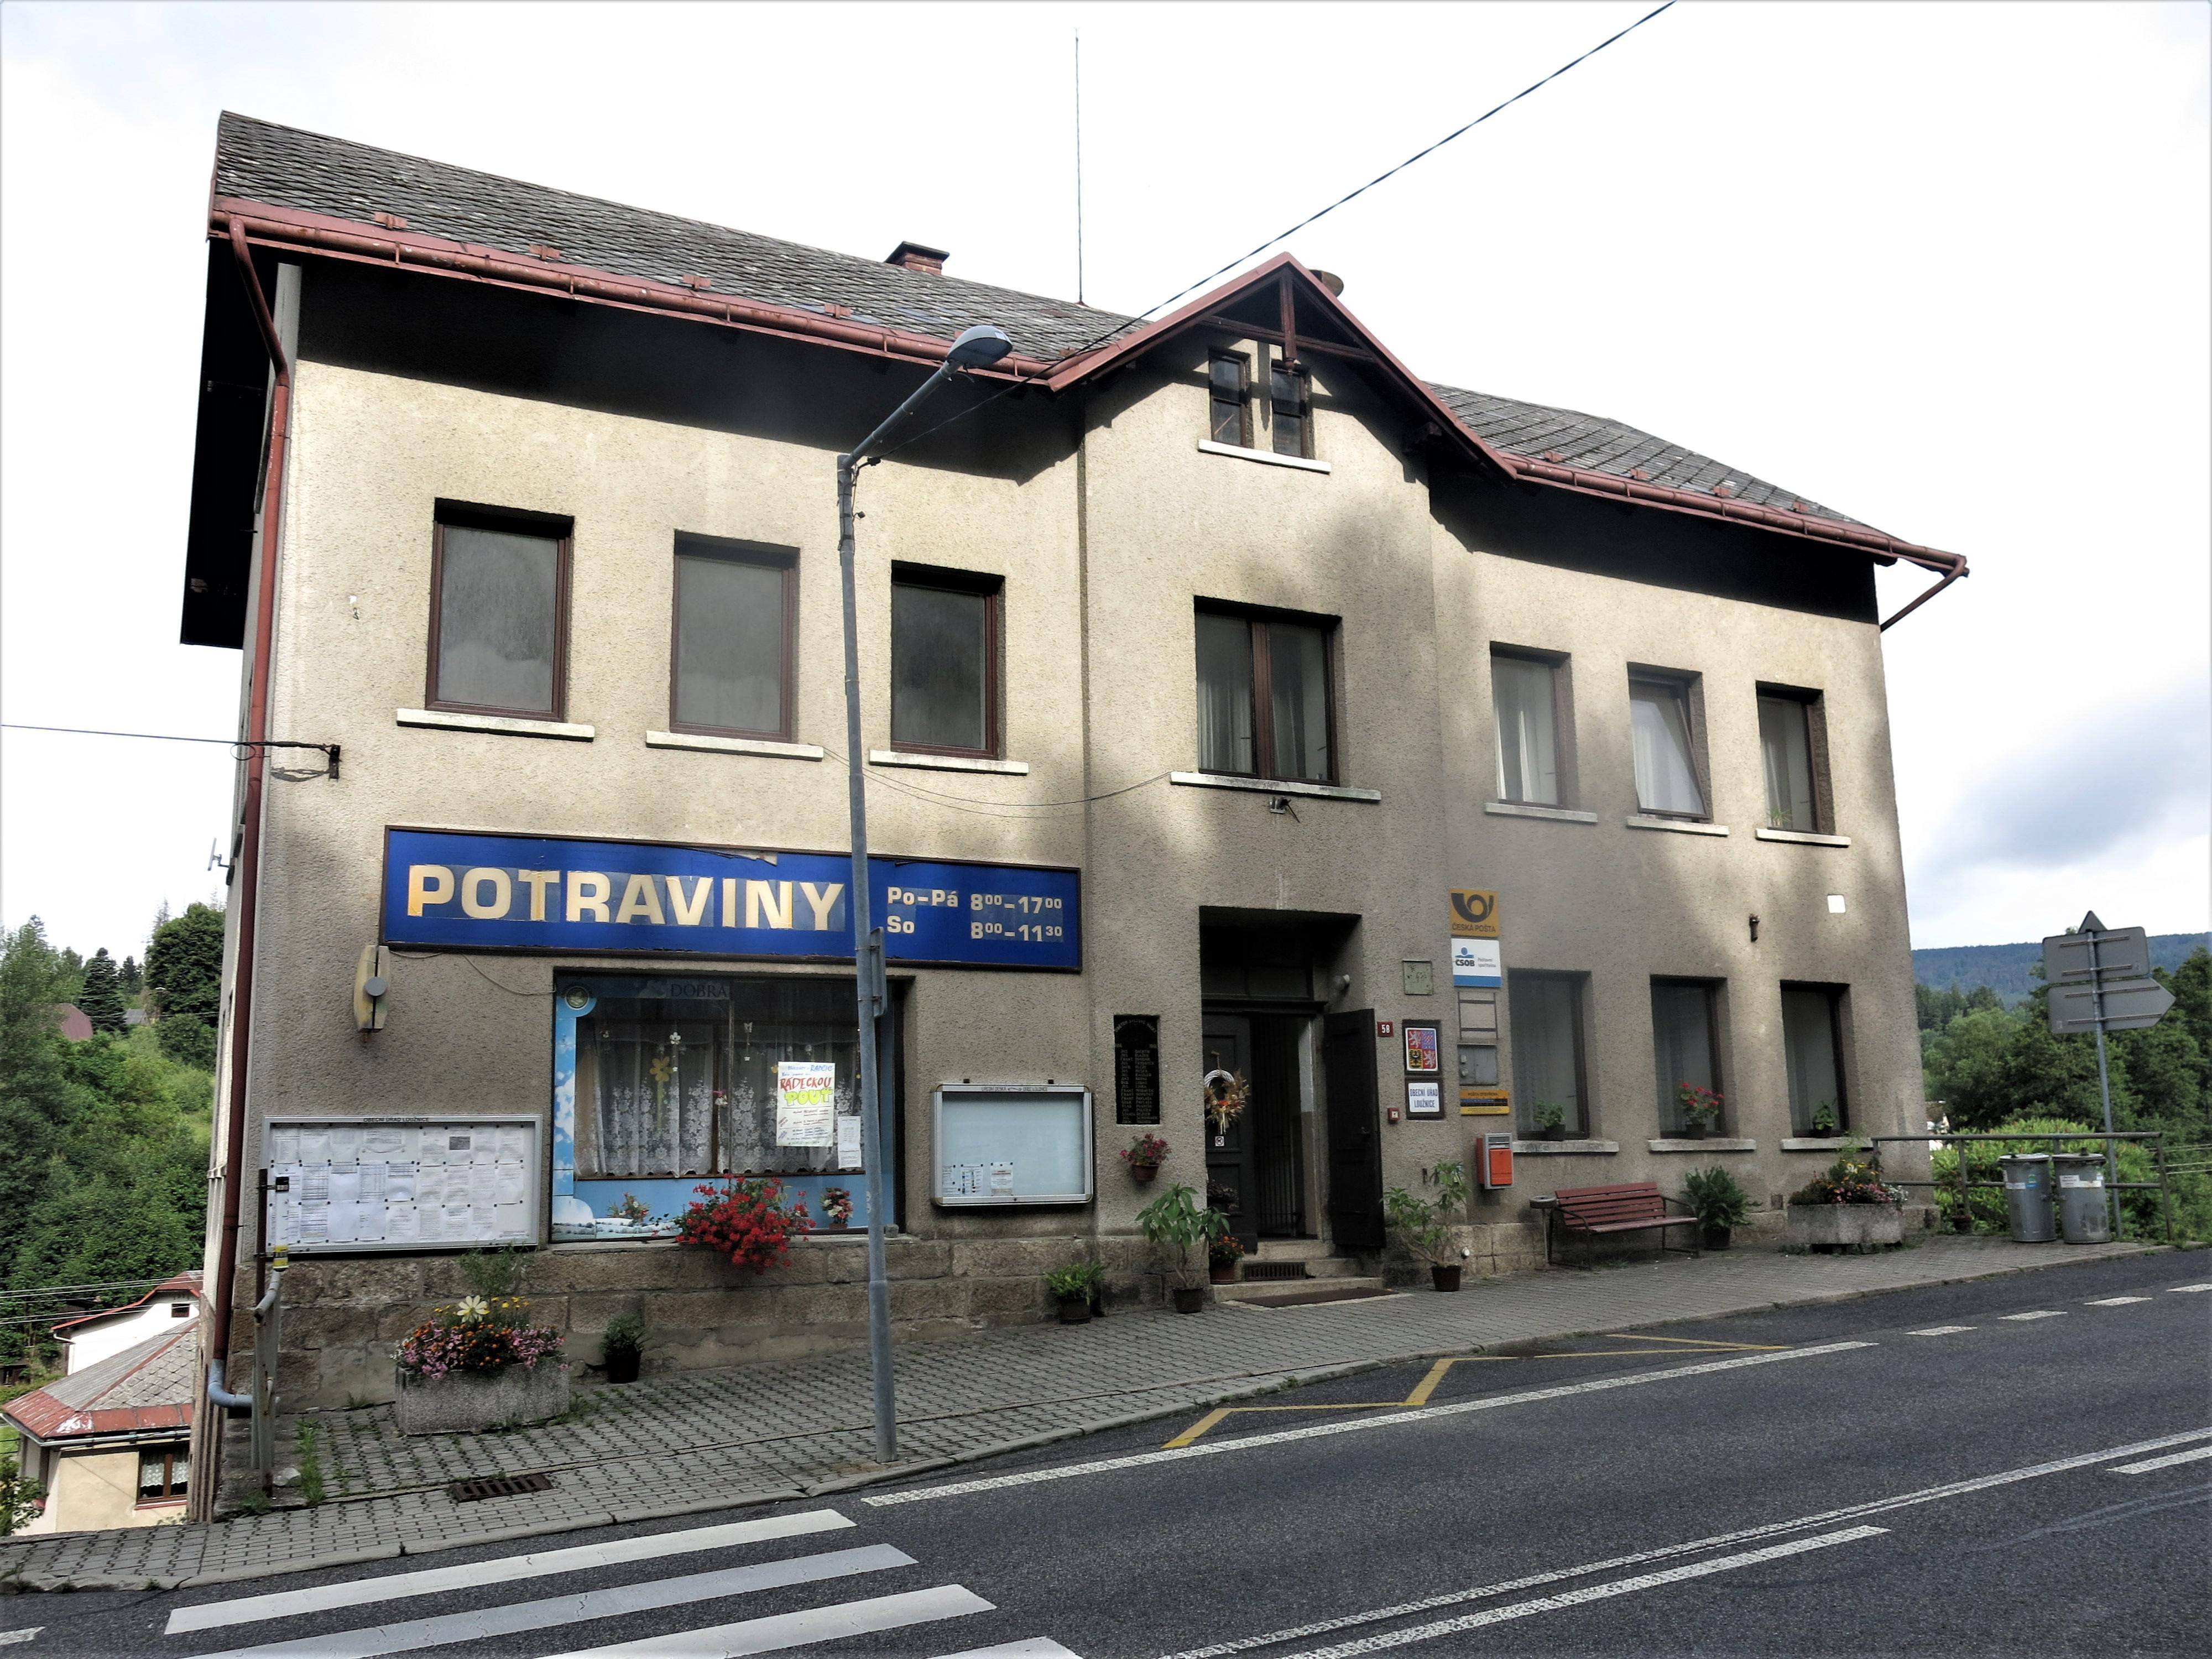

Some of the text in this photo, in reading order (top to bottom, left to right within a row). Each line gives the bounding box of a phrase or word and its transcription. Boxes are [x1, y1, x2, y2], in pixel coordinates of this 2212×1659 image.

[408, 864, 845, 931] POTRAVINY
[887, 886, 958, 907] Po-Pá
[886, 915, 915, 933] So
[1452, 922, 1496, 933] ČESKÁ POŠTA
[1381, 1024, 1390, 1034] 58
[1410, 1087, 1438, 1097] OBECNÍ ÚŘAD
[1414, 1098, 1436, 1108] LOUŽNICE
